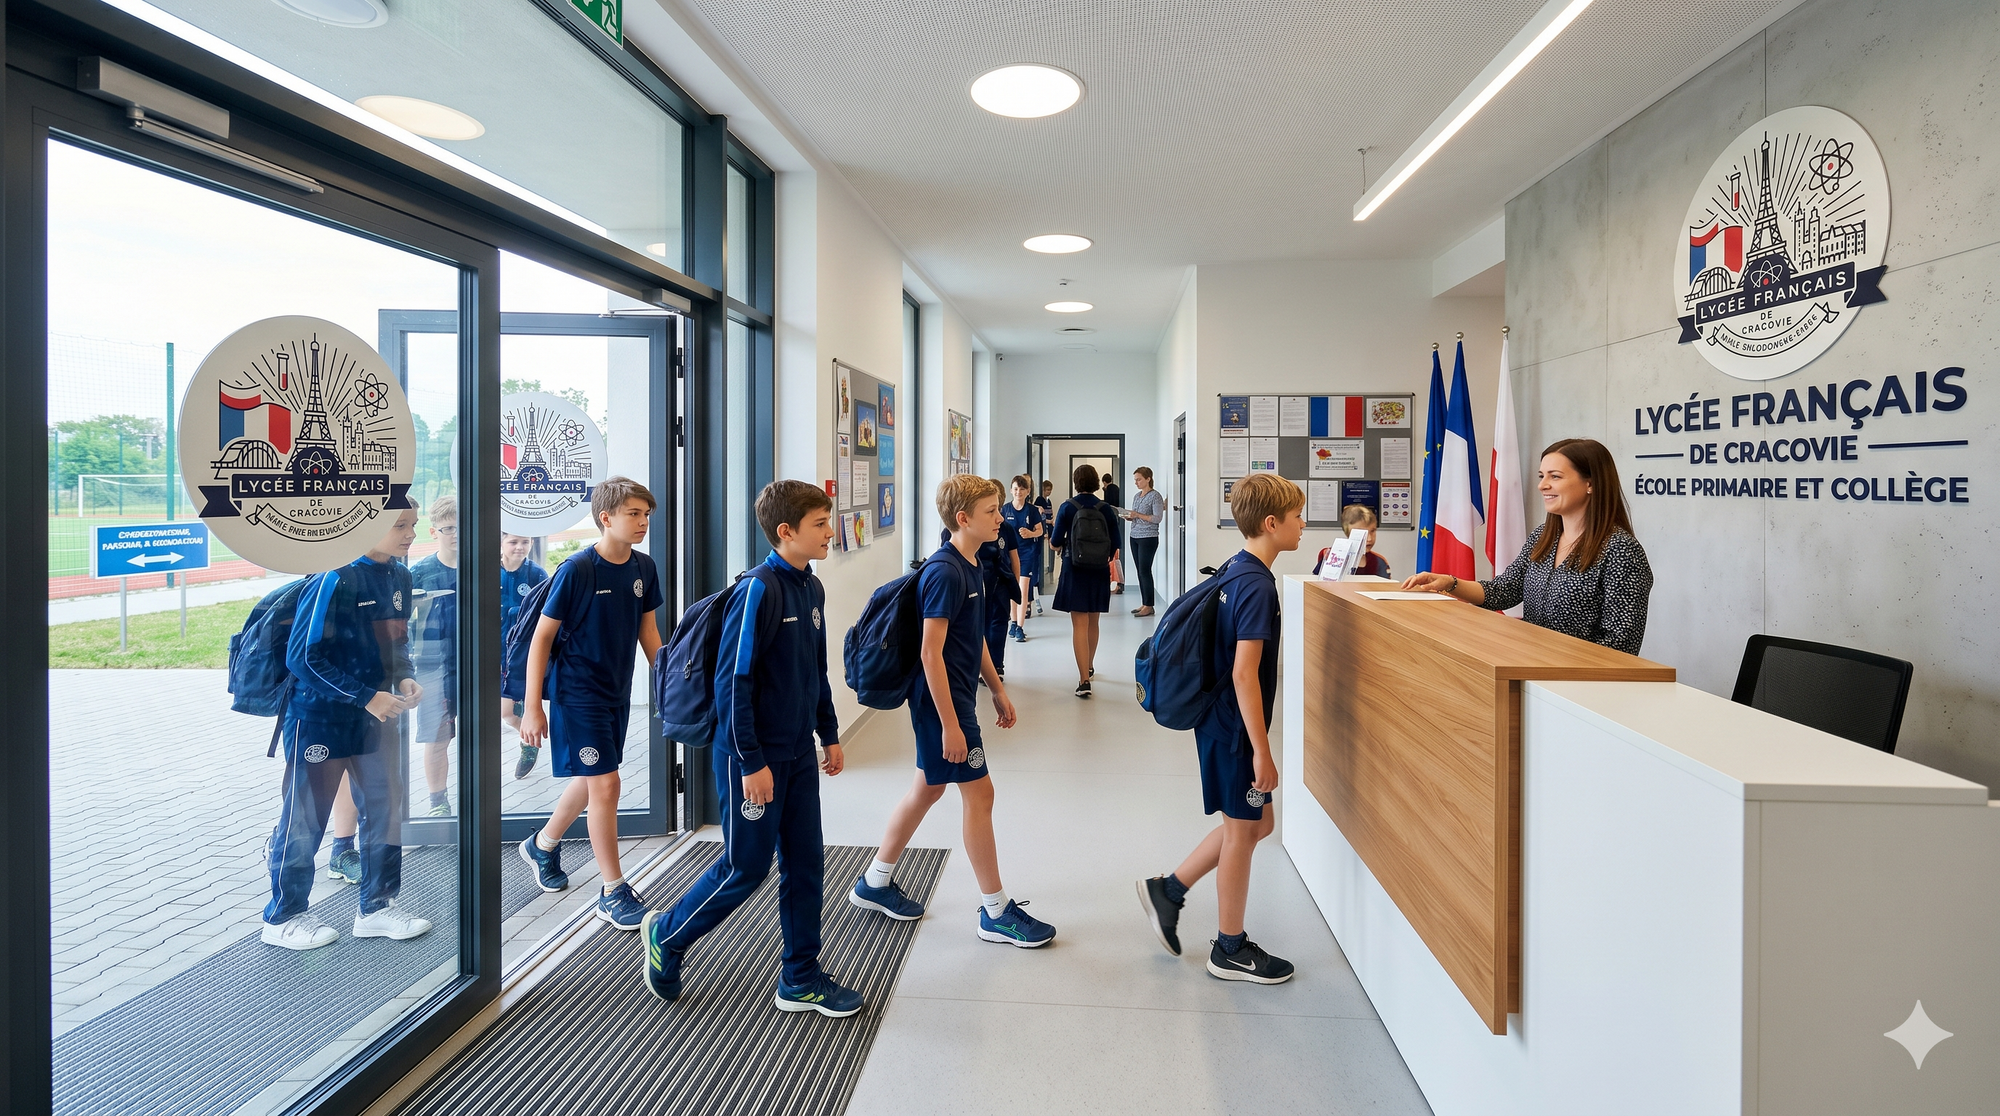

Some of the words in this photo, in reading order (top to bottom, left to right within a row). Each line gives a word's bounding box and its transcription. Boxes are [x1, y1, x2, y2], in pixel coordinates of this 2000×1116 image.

[1700, 296, 1746, 320] LYCÉE
[1754, 271, 1846, 306] FRANÇAIS
[1760, 310, 1773, 321] DE
[1741, 316, 1792, 335] CRACOVIE
[1635, 392, 1720, 435] LYCÉE
[1731, 366, 1968, 430] FRANÇAIS
[1689, 442, 1718, 465] DE
[1723, 434, 1859, 464] CRACOVIE
[239, 476, 295, 493] LYCÉE
[303, 478, 385, 495] FRANÇAIS
[500, 482, 519, 491] CÉE
[524, 483, 582, 492] FRANÇAIS
[1635, 473, 1687, 495] ÉCOLE
[1691, 477, 1788, 498] PRIMAIRE
[1795, 477, 1824, 499] ET
[1830, 471, 1970, 503] COLLÈGE
[289, 507, 342, 518] CRACOVIE
[310, 499, 323, 507] DE
